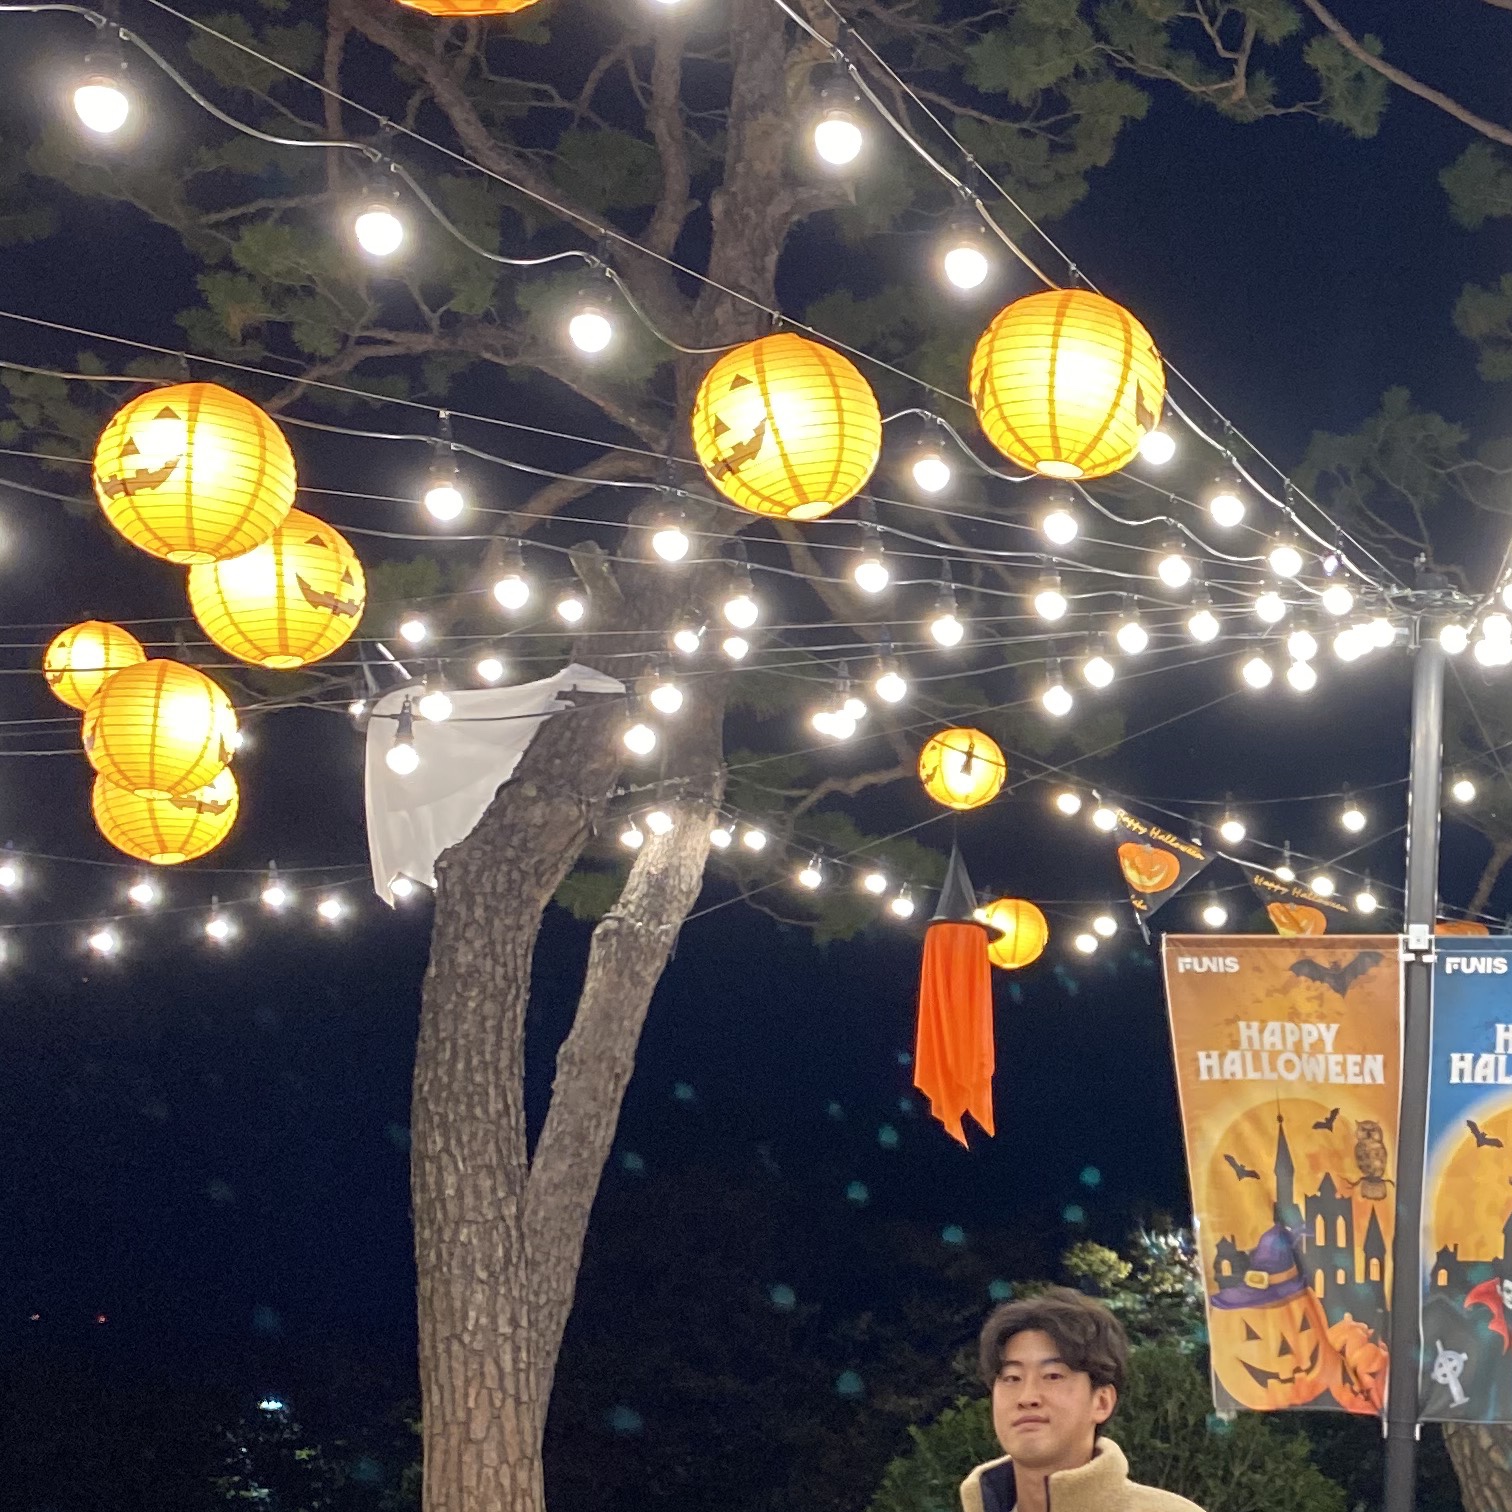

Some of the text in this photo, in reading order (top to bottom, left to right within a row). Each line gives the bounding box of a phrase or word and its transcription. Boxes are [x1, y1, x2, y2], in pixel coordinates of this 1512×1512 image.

[1177, 956, 1240, 973] FUNIS
[1445, 956, 1508, 974] FUNIS
[1237, 1020, 1340, 1053] HAPPY
[1197, 1050, 1385, 1085] HALLOWEEN
